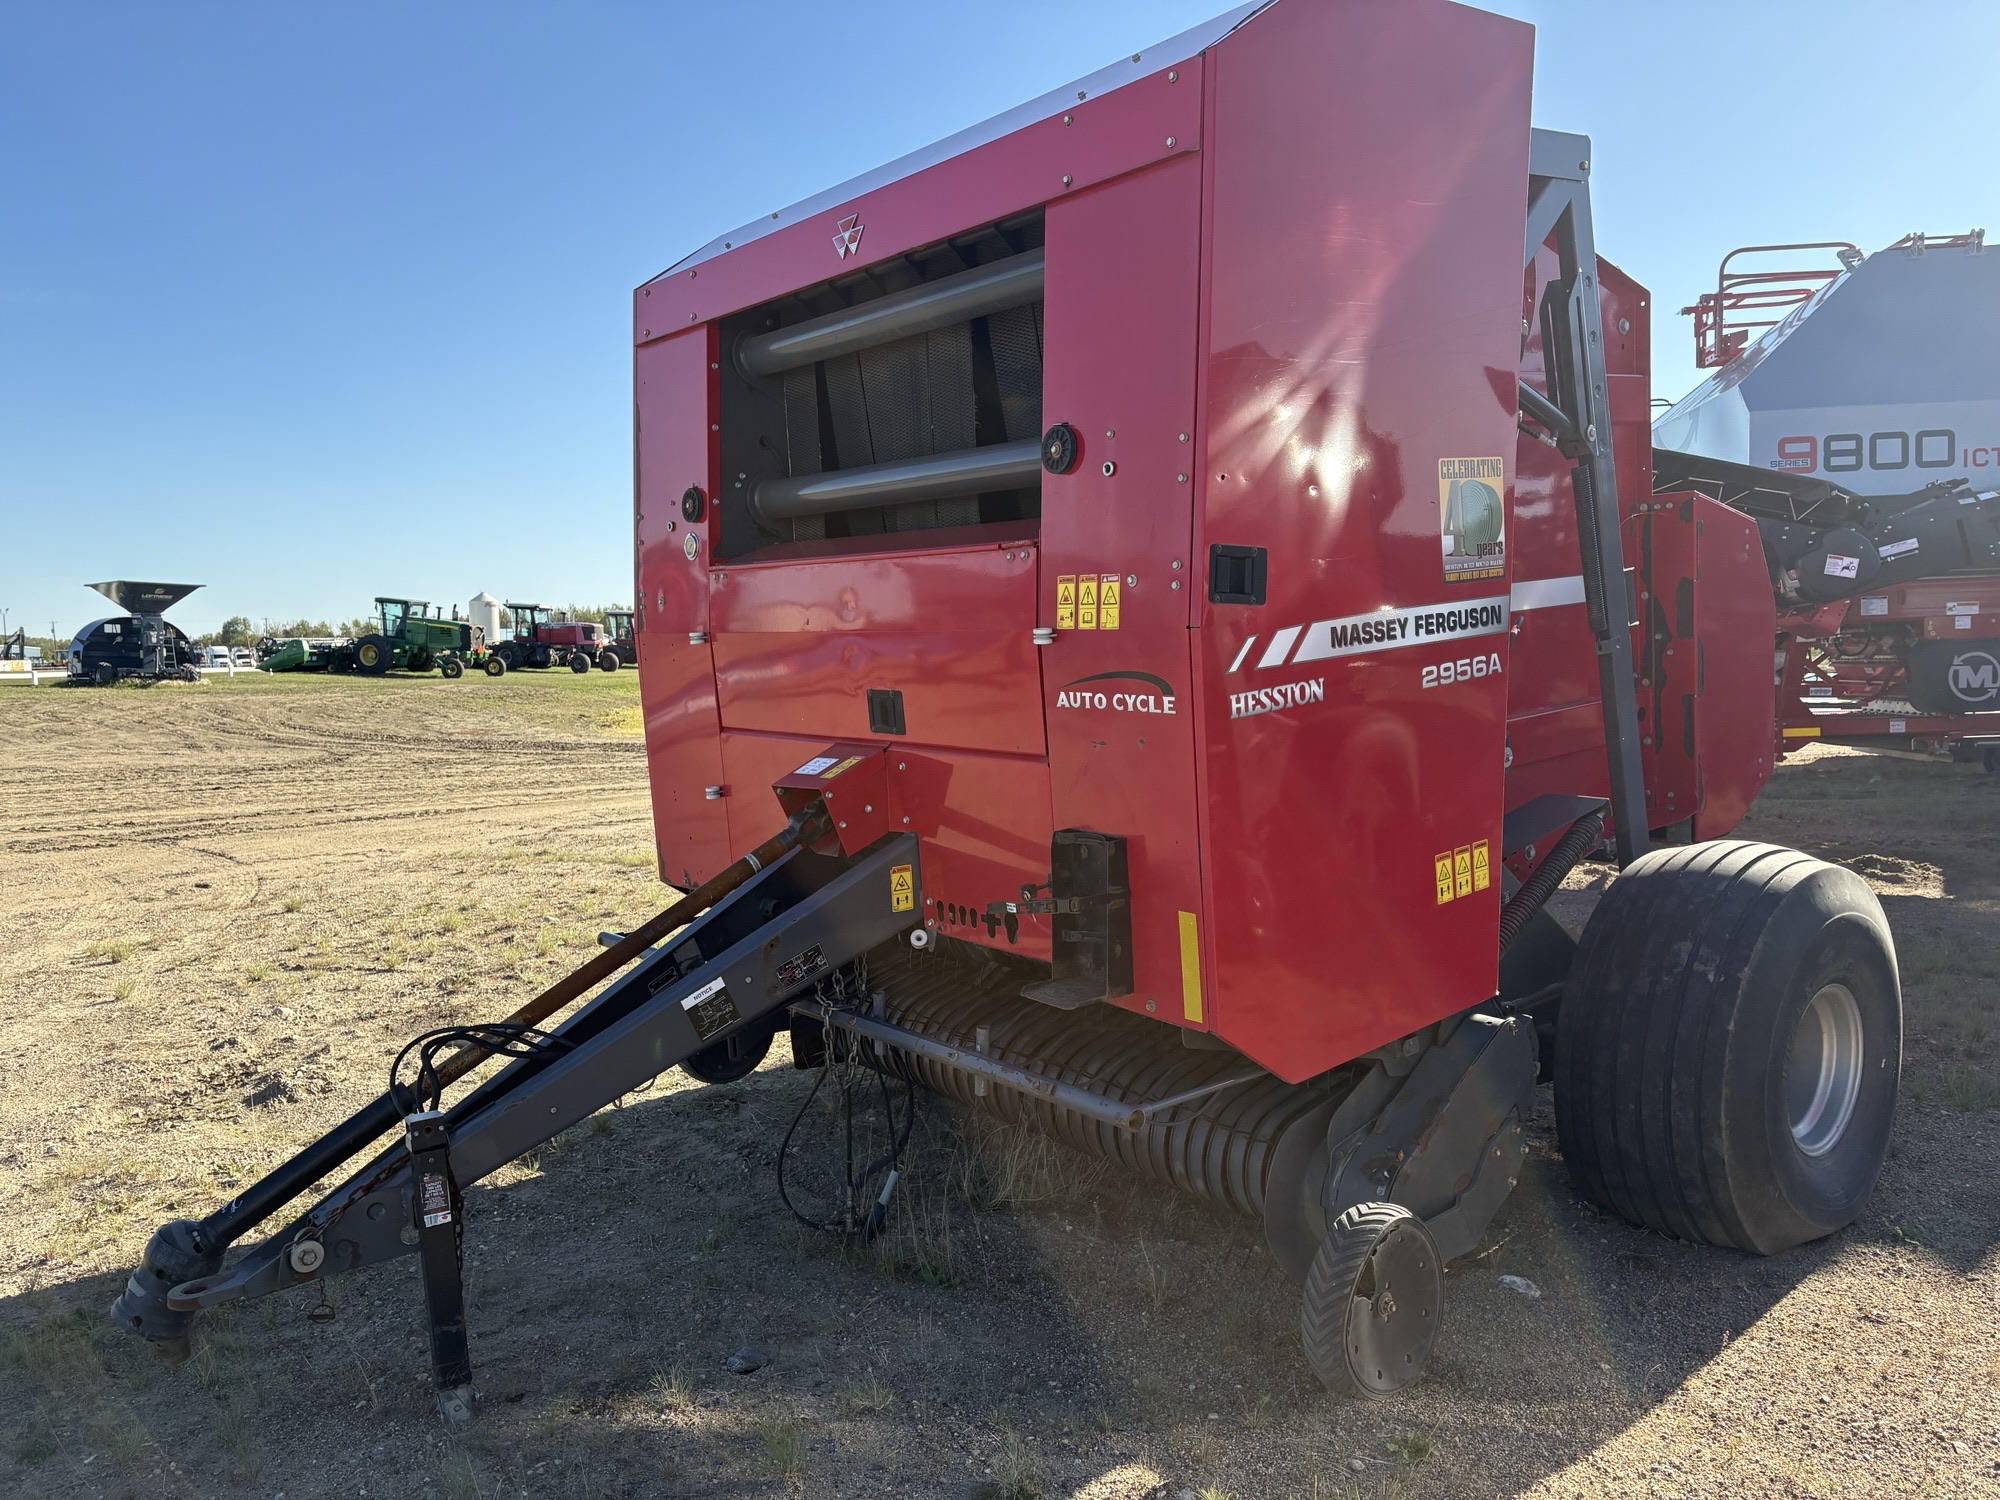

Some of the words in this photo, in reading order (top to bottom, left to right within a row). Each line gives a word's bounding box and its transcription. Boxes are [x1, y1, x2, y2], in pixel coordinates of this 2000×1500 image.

[1769, 459, 1809, 468] SERIES
[1777, 429, 1956, 474] 9800
[1963, 447, 2000, 468] ICT
[1440, 459, 1502, 480] CELEBRATING
[1476, 541, 1504, 560] years
[1330, 617, 1409, 649] MASSEY
[1414, 604, 1502, 636] FERGUSON
[1421, 652, 1503, 689] 2956A
[1056, 691, 1107, 710] AUTO
[1112, 693, 1177, 715] CYCLE
[1229, 678, 1325, 720] HESSTON
[693, 985, 714, 1001] NOTICE
